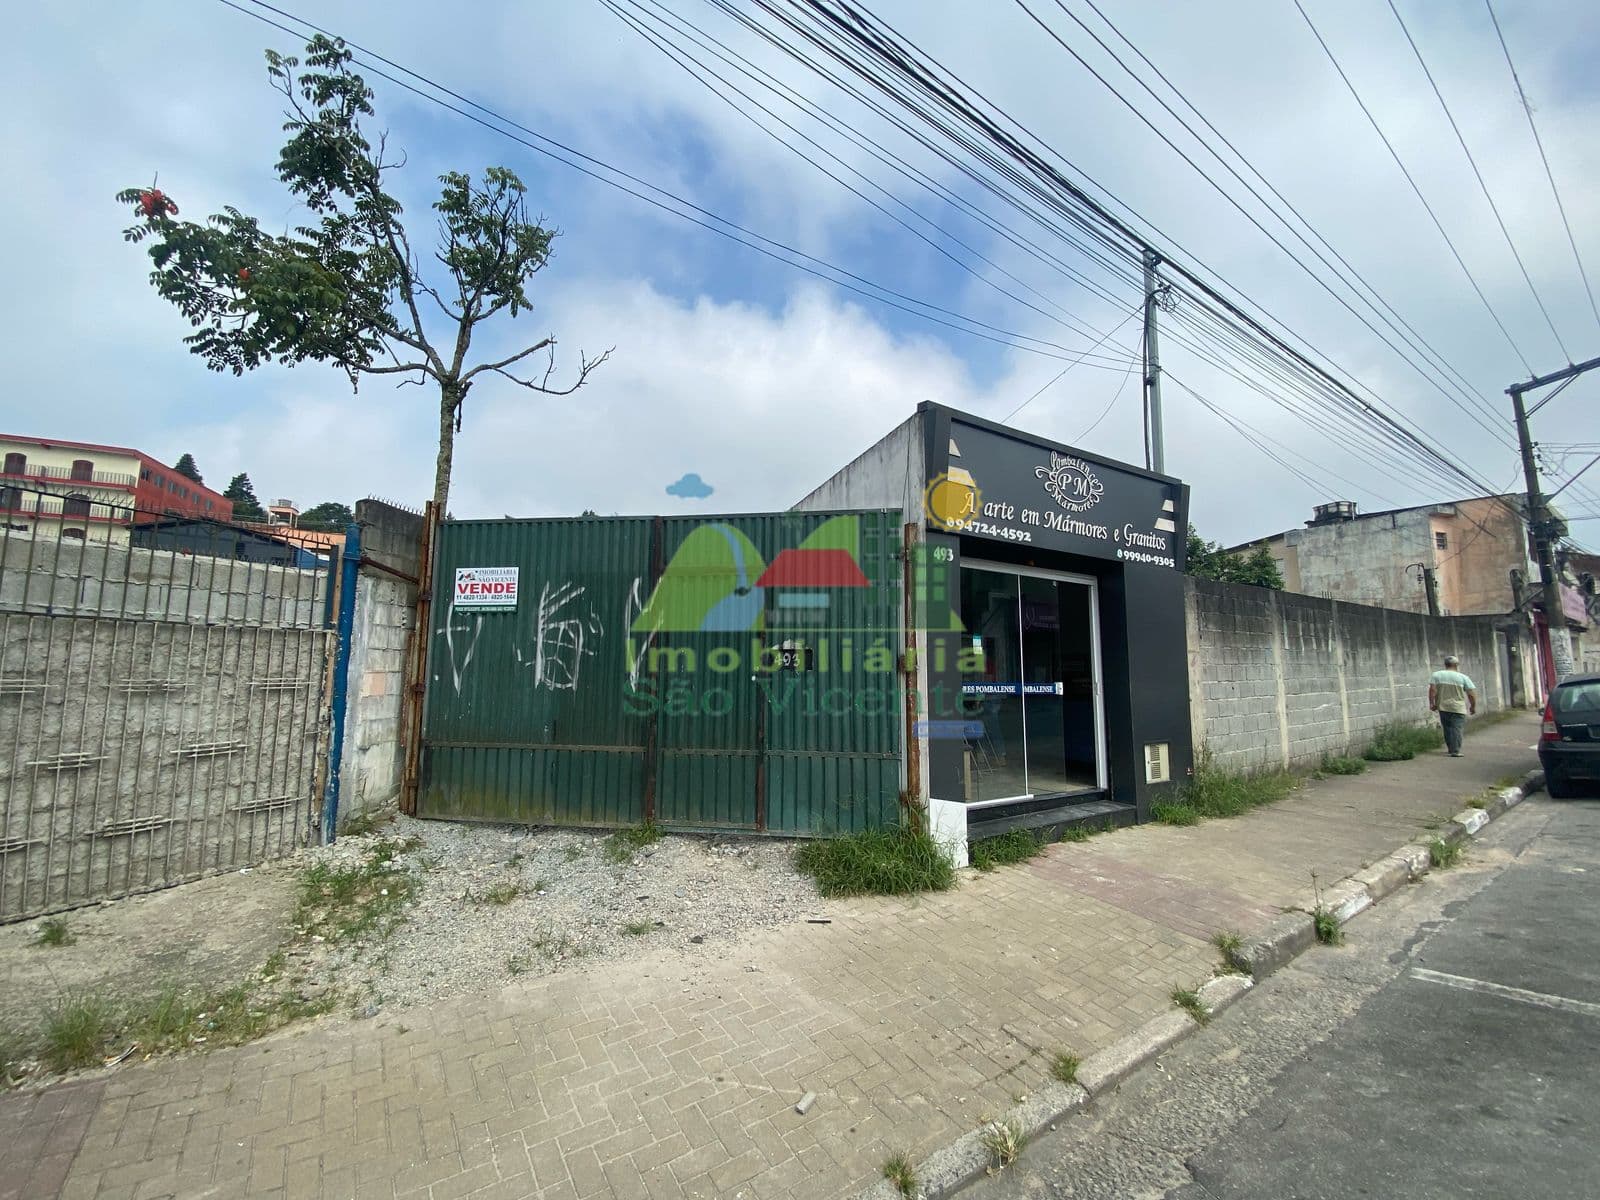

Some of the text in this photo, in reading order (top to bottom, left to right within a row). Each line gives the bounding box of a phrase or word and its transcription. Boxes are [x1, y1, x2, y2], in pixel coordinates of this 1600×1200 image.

[960, 492, 1166, 551] A arte em Mármores e Granitos
[933, 545, 954, 562] 493
[457, 582, 517, 594] VENDE
[774, 652, 800, 667] 493
[975, 685, 1016, 693] POMBALENSE
